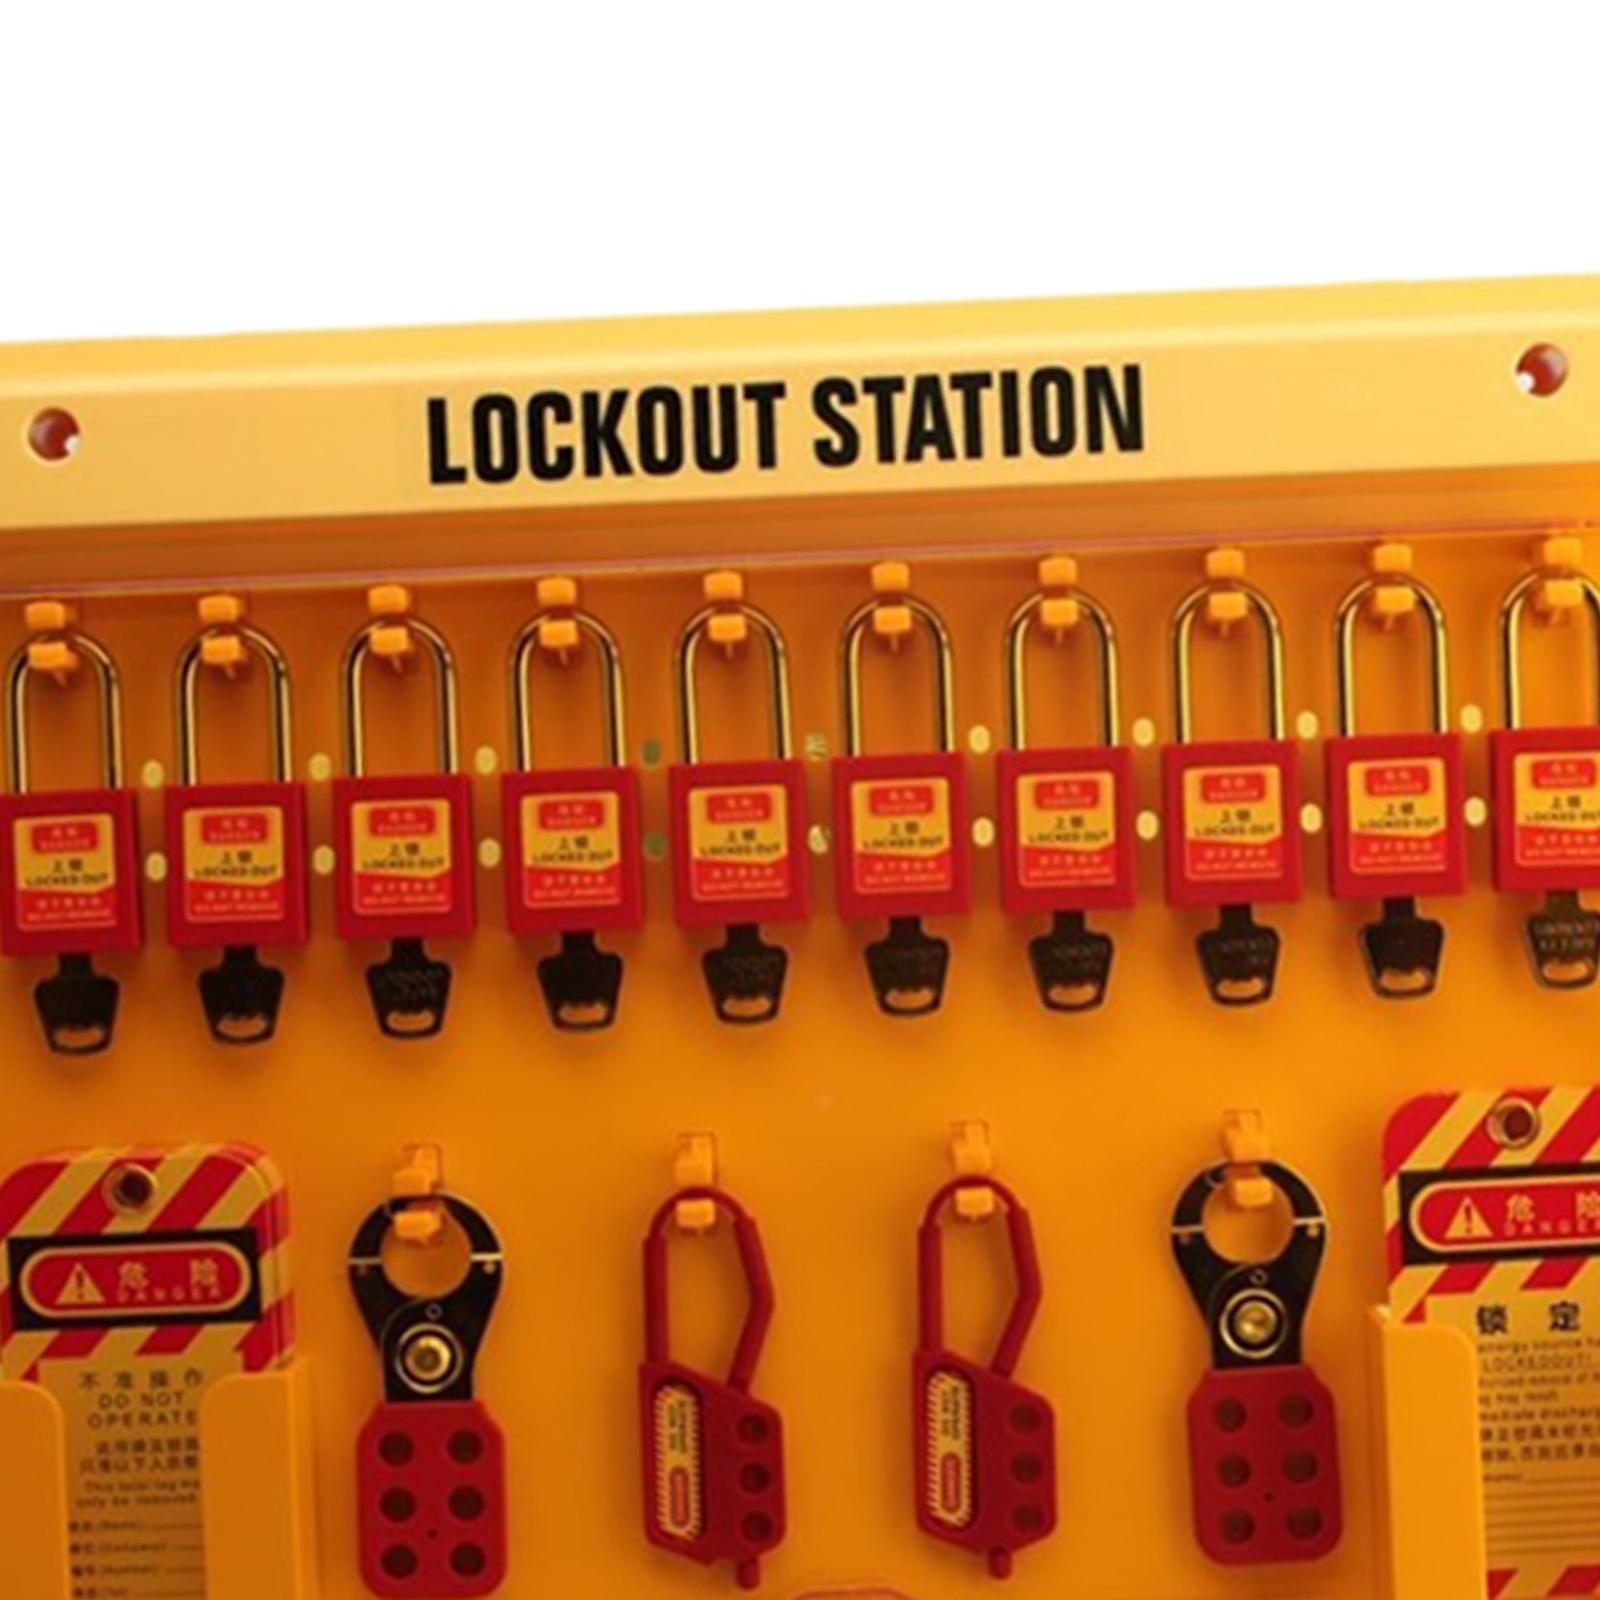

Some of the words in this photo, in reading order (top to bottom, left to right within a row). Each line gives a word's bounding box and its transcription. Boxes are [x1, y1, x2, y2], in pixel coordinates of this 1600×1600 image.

[428, 382, 786, 484] LOCKOUT
[812, 364, 1143, 467] STATION
[98, 1392, 130, 1410] DO
[140, 1390, 183, 1407] NOT
[87, 1409, 199, 1429] OPERATE
